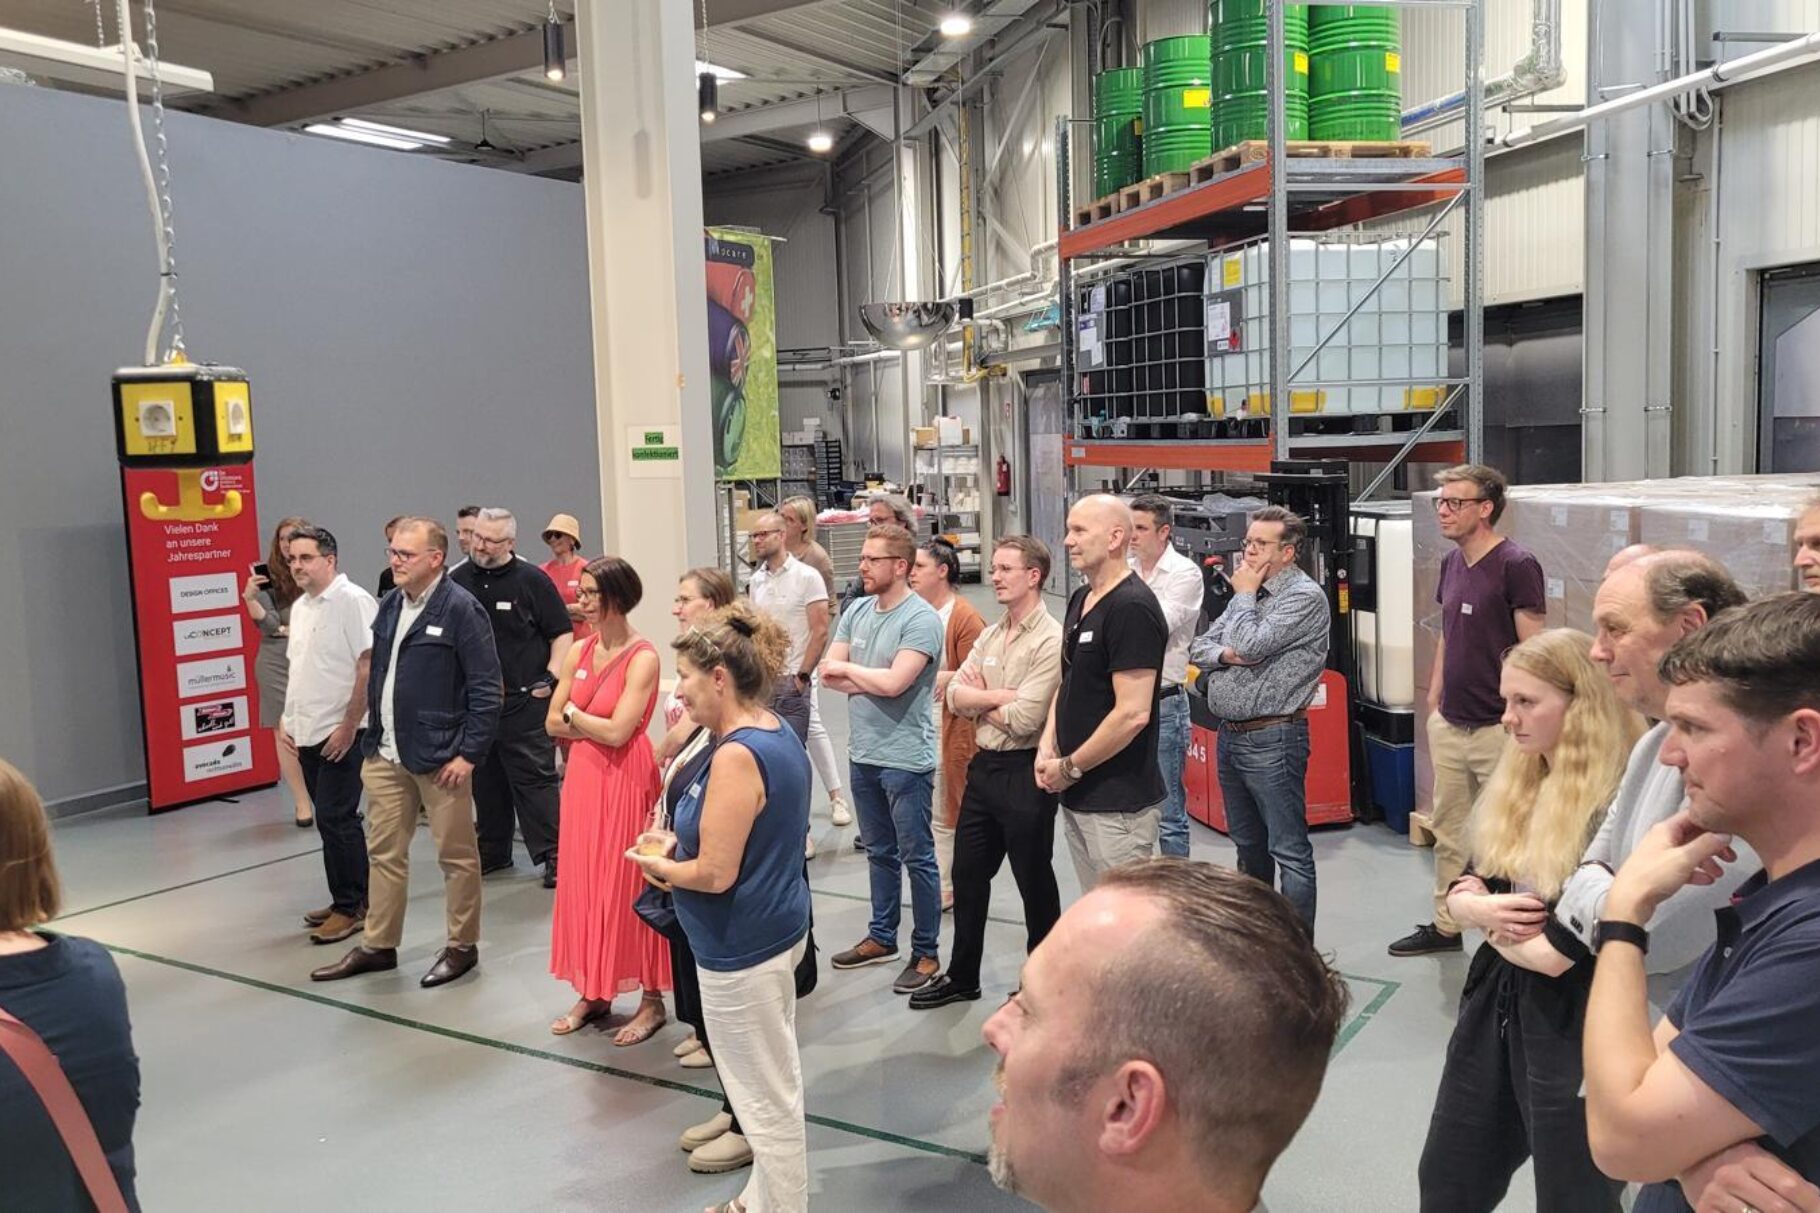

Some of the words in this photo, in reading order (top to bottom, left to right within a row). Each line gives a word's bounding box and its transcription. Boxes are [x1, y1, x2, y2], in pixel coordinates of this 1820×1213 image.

[164, 525, 194, 534] Vielen
[196, 522, 219, 533] Dank
[166, 540, 178, 548] an
[180, 537, 211, 547] unsere
[167, 549, 232, 562] Jahrespartner
